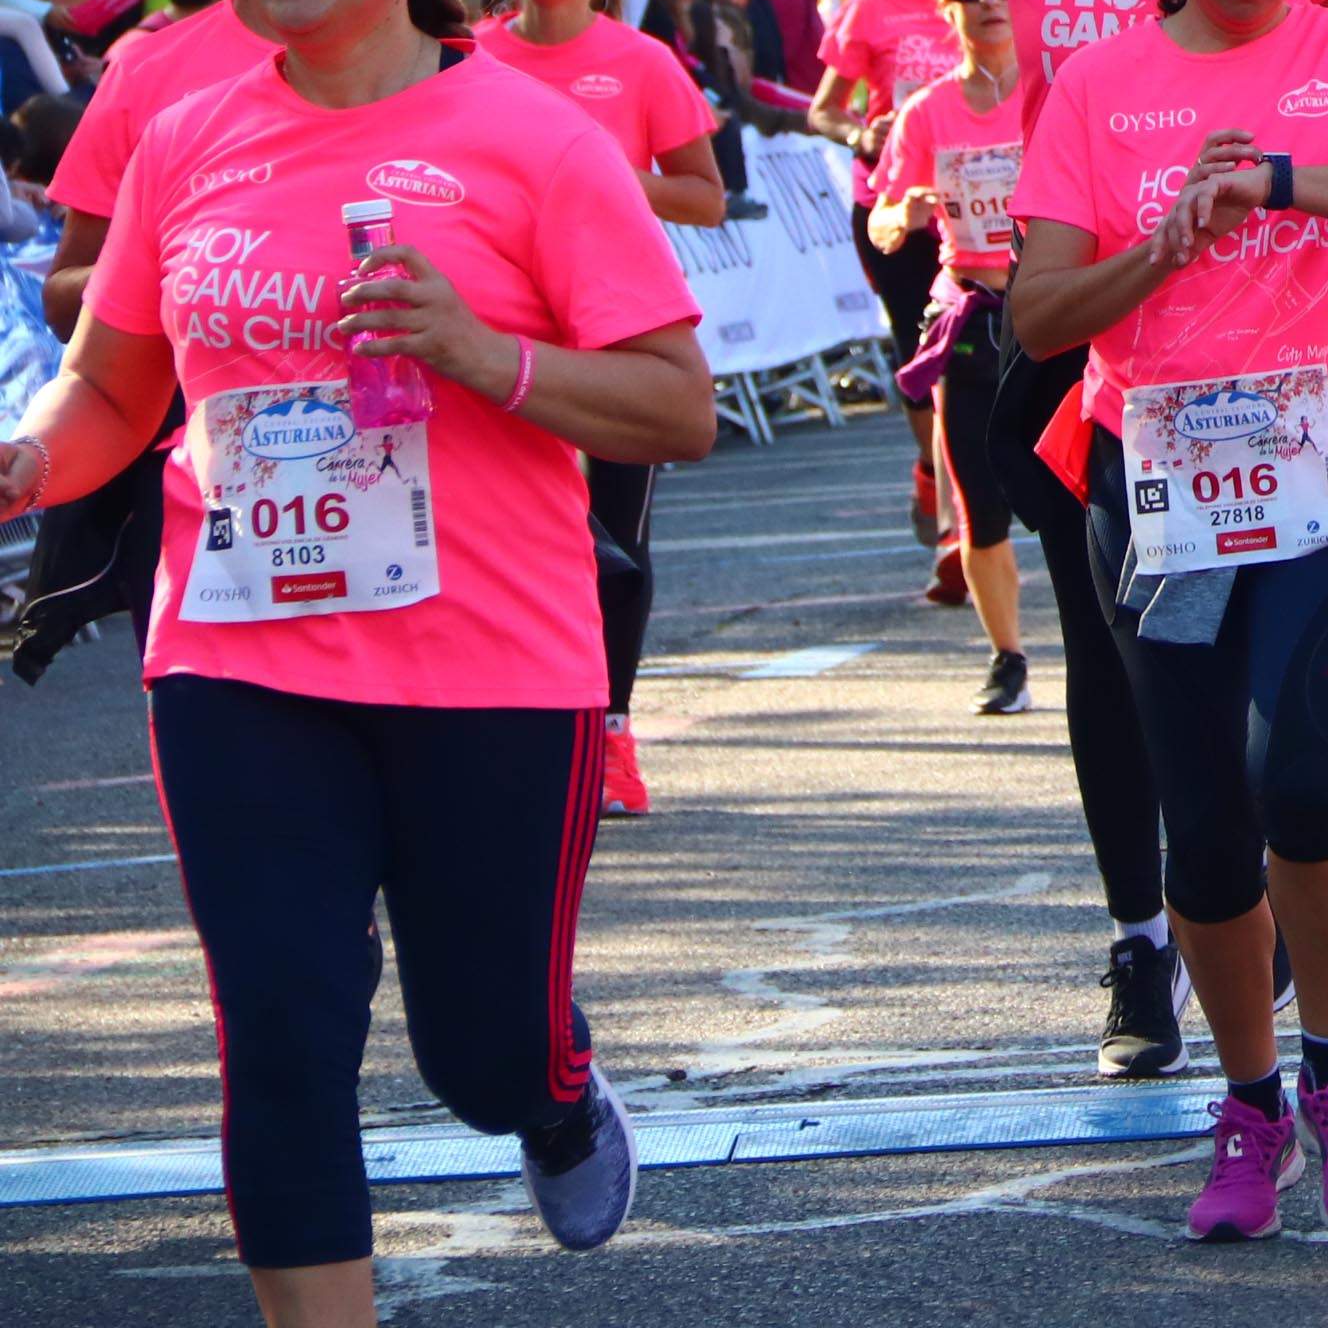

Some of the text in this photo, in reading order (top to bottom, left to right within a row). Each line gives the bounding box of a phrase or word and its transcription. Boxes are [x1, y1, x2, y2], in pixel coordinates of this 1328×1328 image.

[1109, 107, 1197, 133] OYSHO
[373, 168, 457, 201] ASTURIANA
[1137, 165, 1190, 202] HO
[180, 227, 272, 264] HOY
[172, 266, 325, 313] GANAN
[243, 315, 344, 351] CHIC
[1277, 344, 1303, 365] City
[1182, 410, 1271, 432] ASTURIANA
[249, 424, 346, 448] ASTURIANA
[1191, 463, 1279, 504] 016
[251, 493, 350, 539] 016
[1210, 506, 1265, 527] 27818
[272, 546, 326, 567] 8103
[1146, 542, 1196, 558] OYSHO
[1233, 535, 1269, 547] Santander
[200, 580, 419, 602] OYSHO Santander ZURICH
